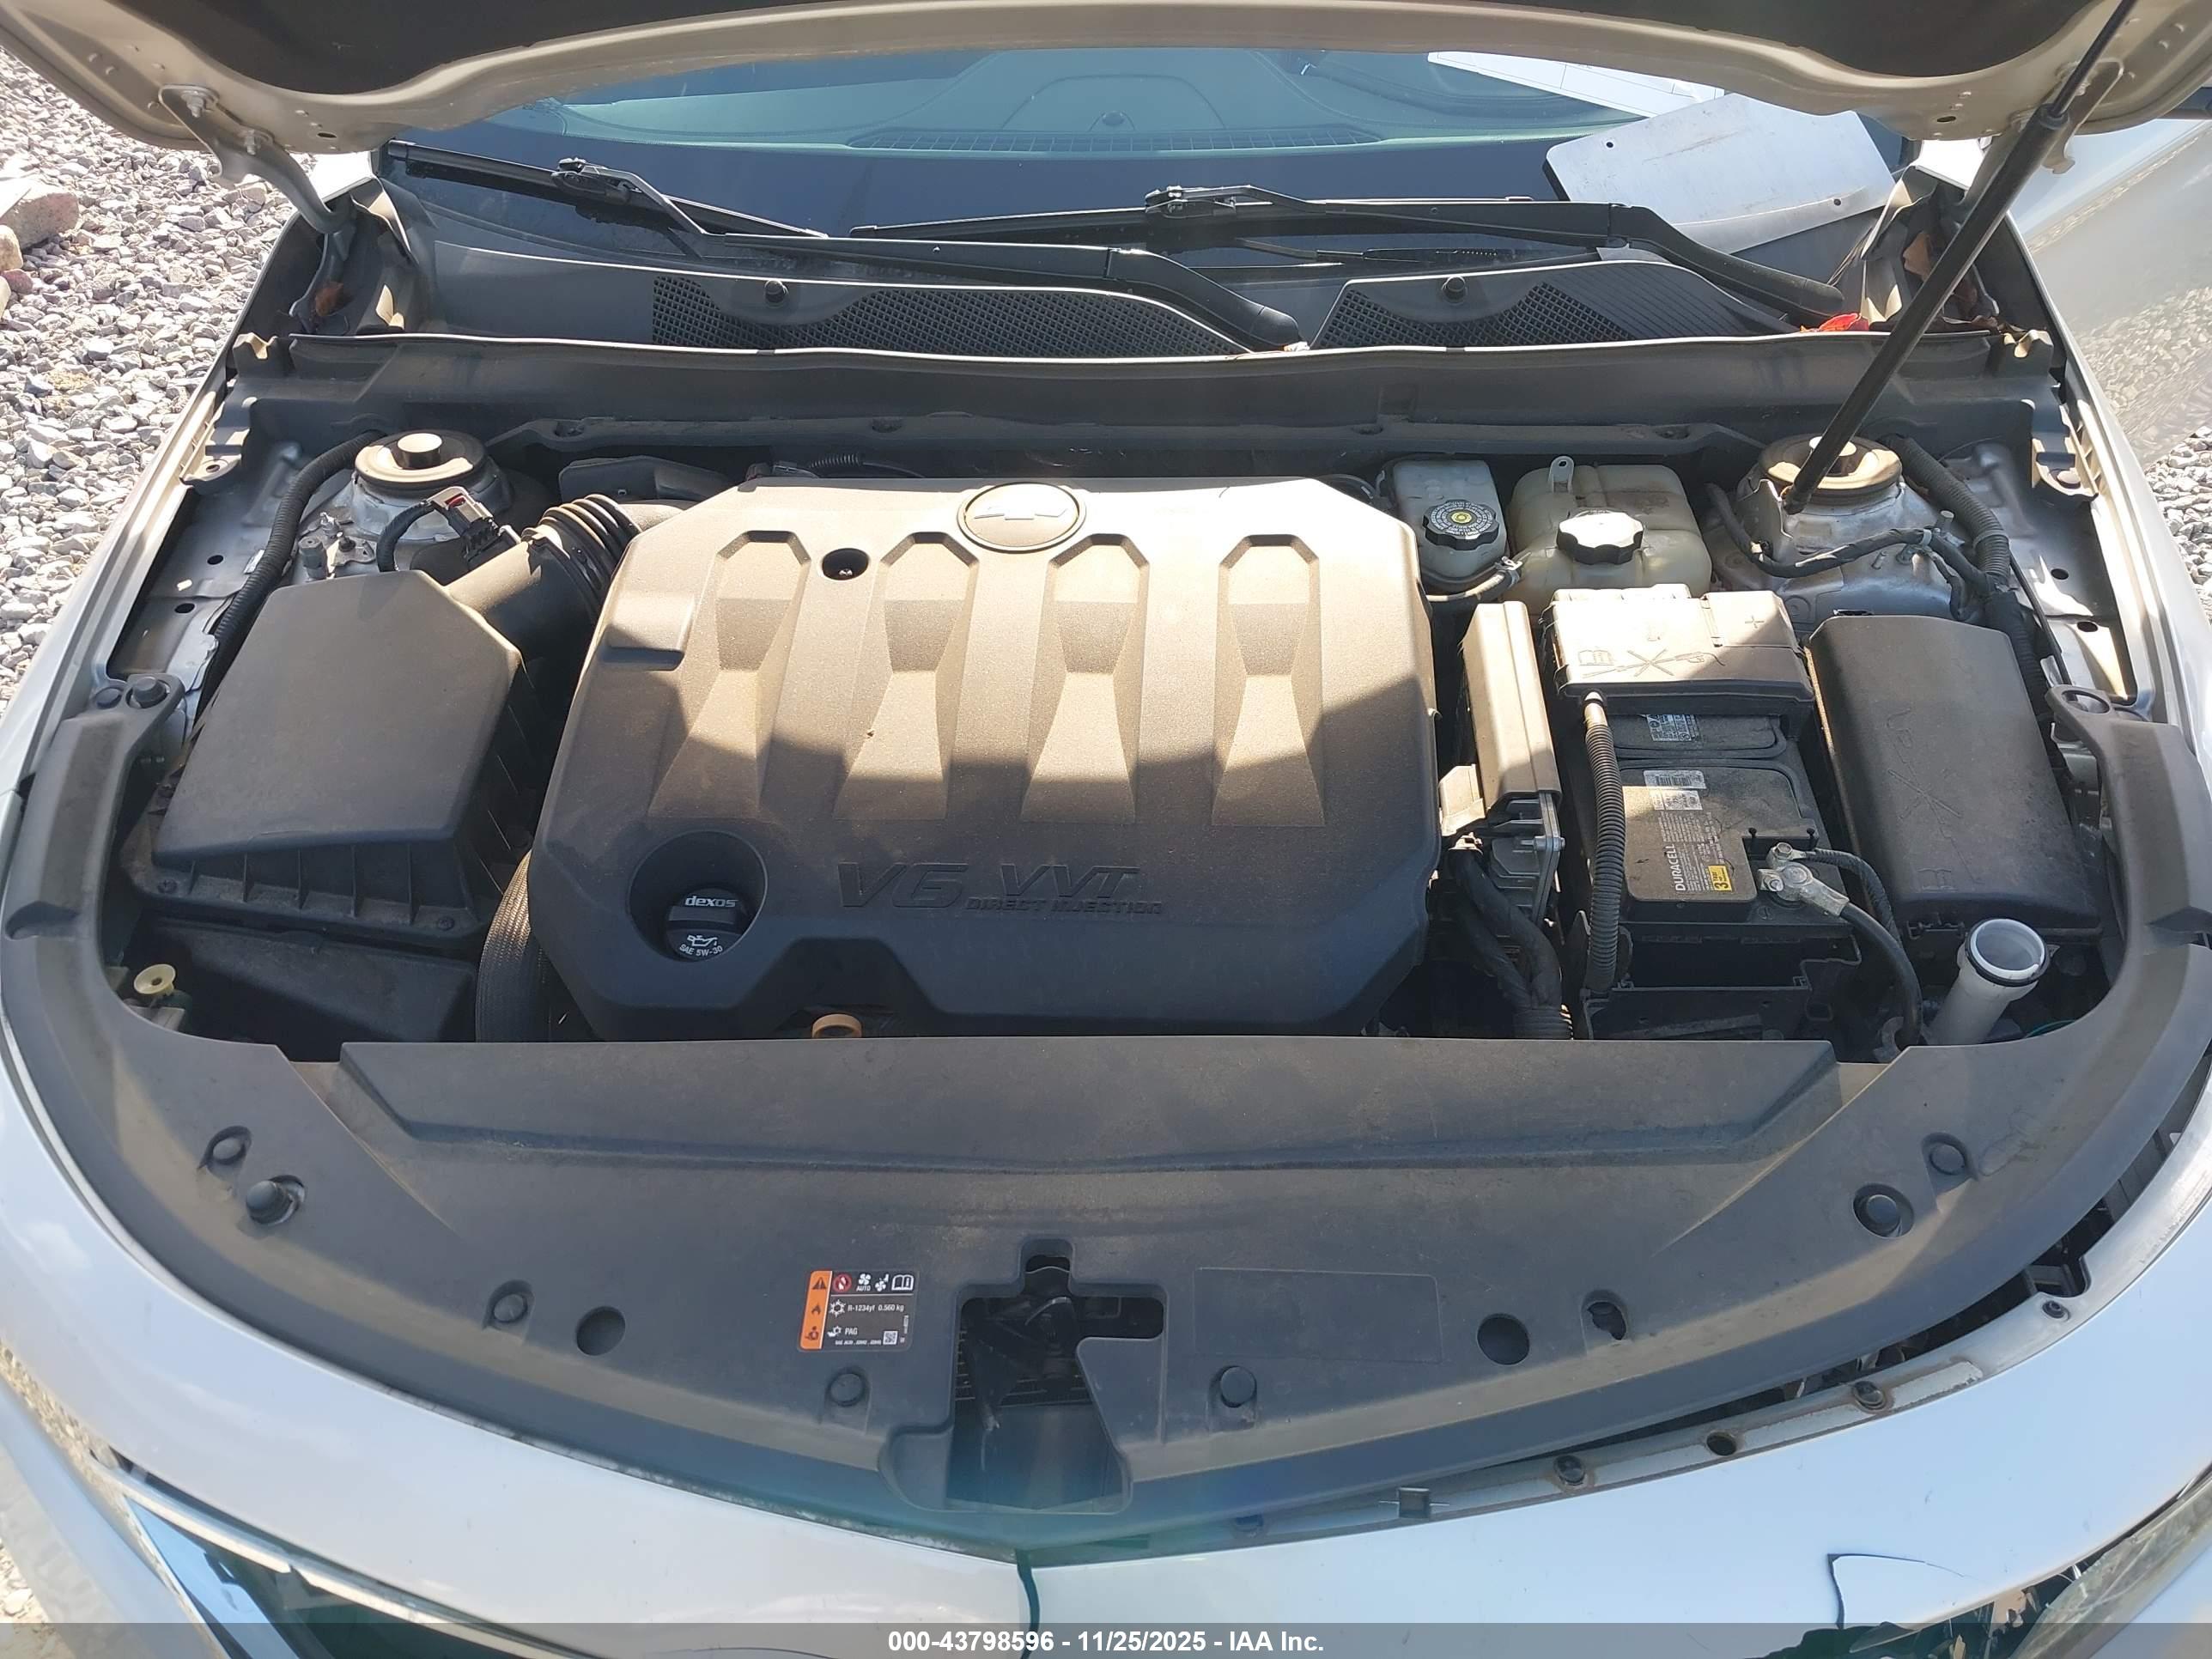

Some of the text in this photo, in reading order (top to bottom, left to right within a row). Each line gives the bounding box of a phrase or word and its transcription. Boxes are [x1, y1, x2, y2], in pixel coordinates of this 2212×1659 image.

[1666, 843, 1686, 891] DURACELL
[837, 861, 1140, 908] V6 VVT
[685, 896, 738, 908] dexos
[679, 944, 723, 957] SAE 5W-30
[847, 1304, 875, 1313] R-1234yf
[896, 1304, 904, 1313] kg
[844, 1327, 858, 1335] PAG
